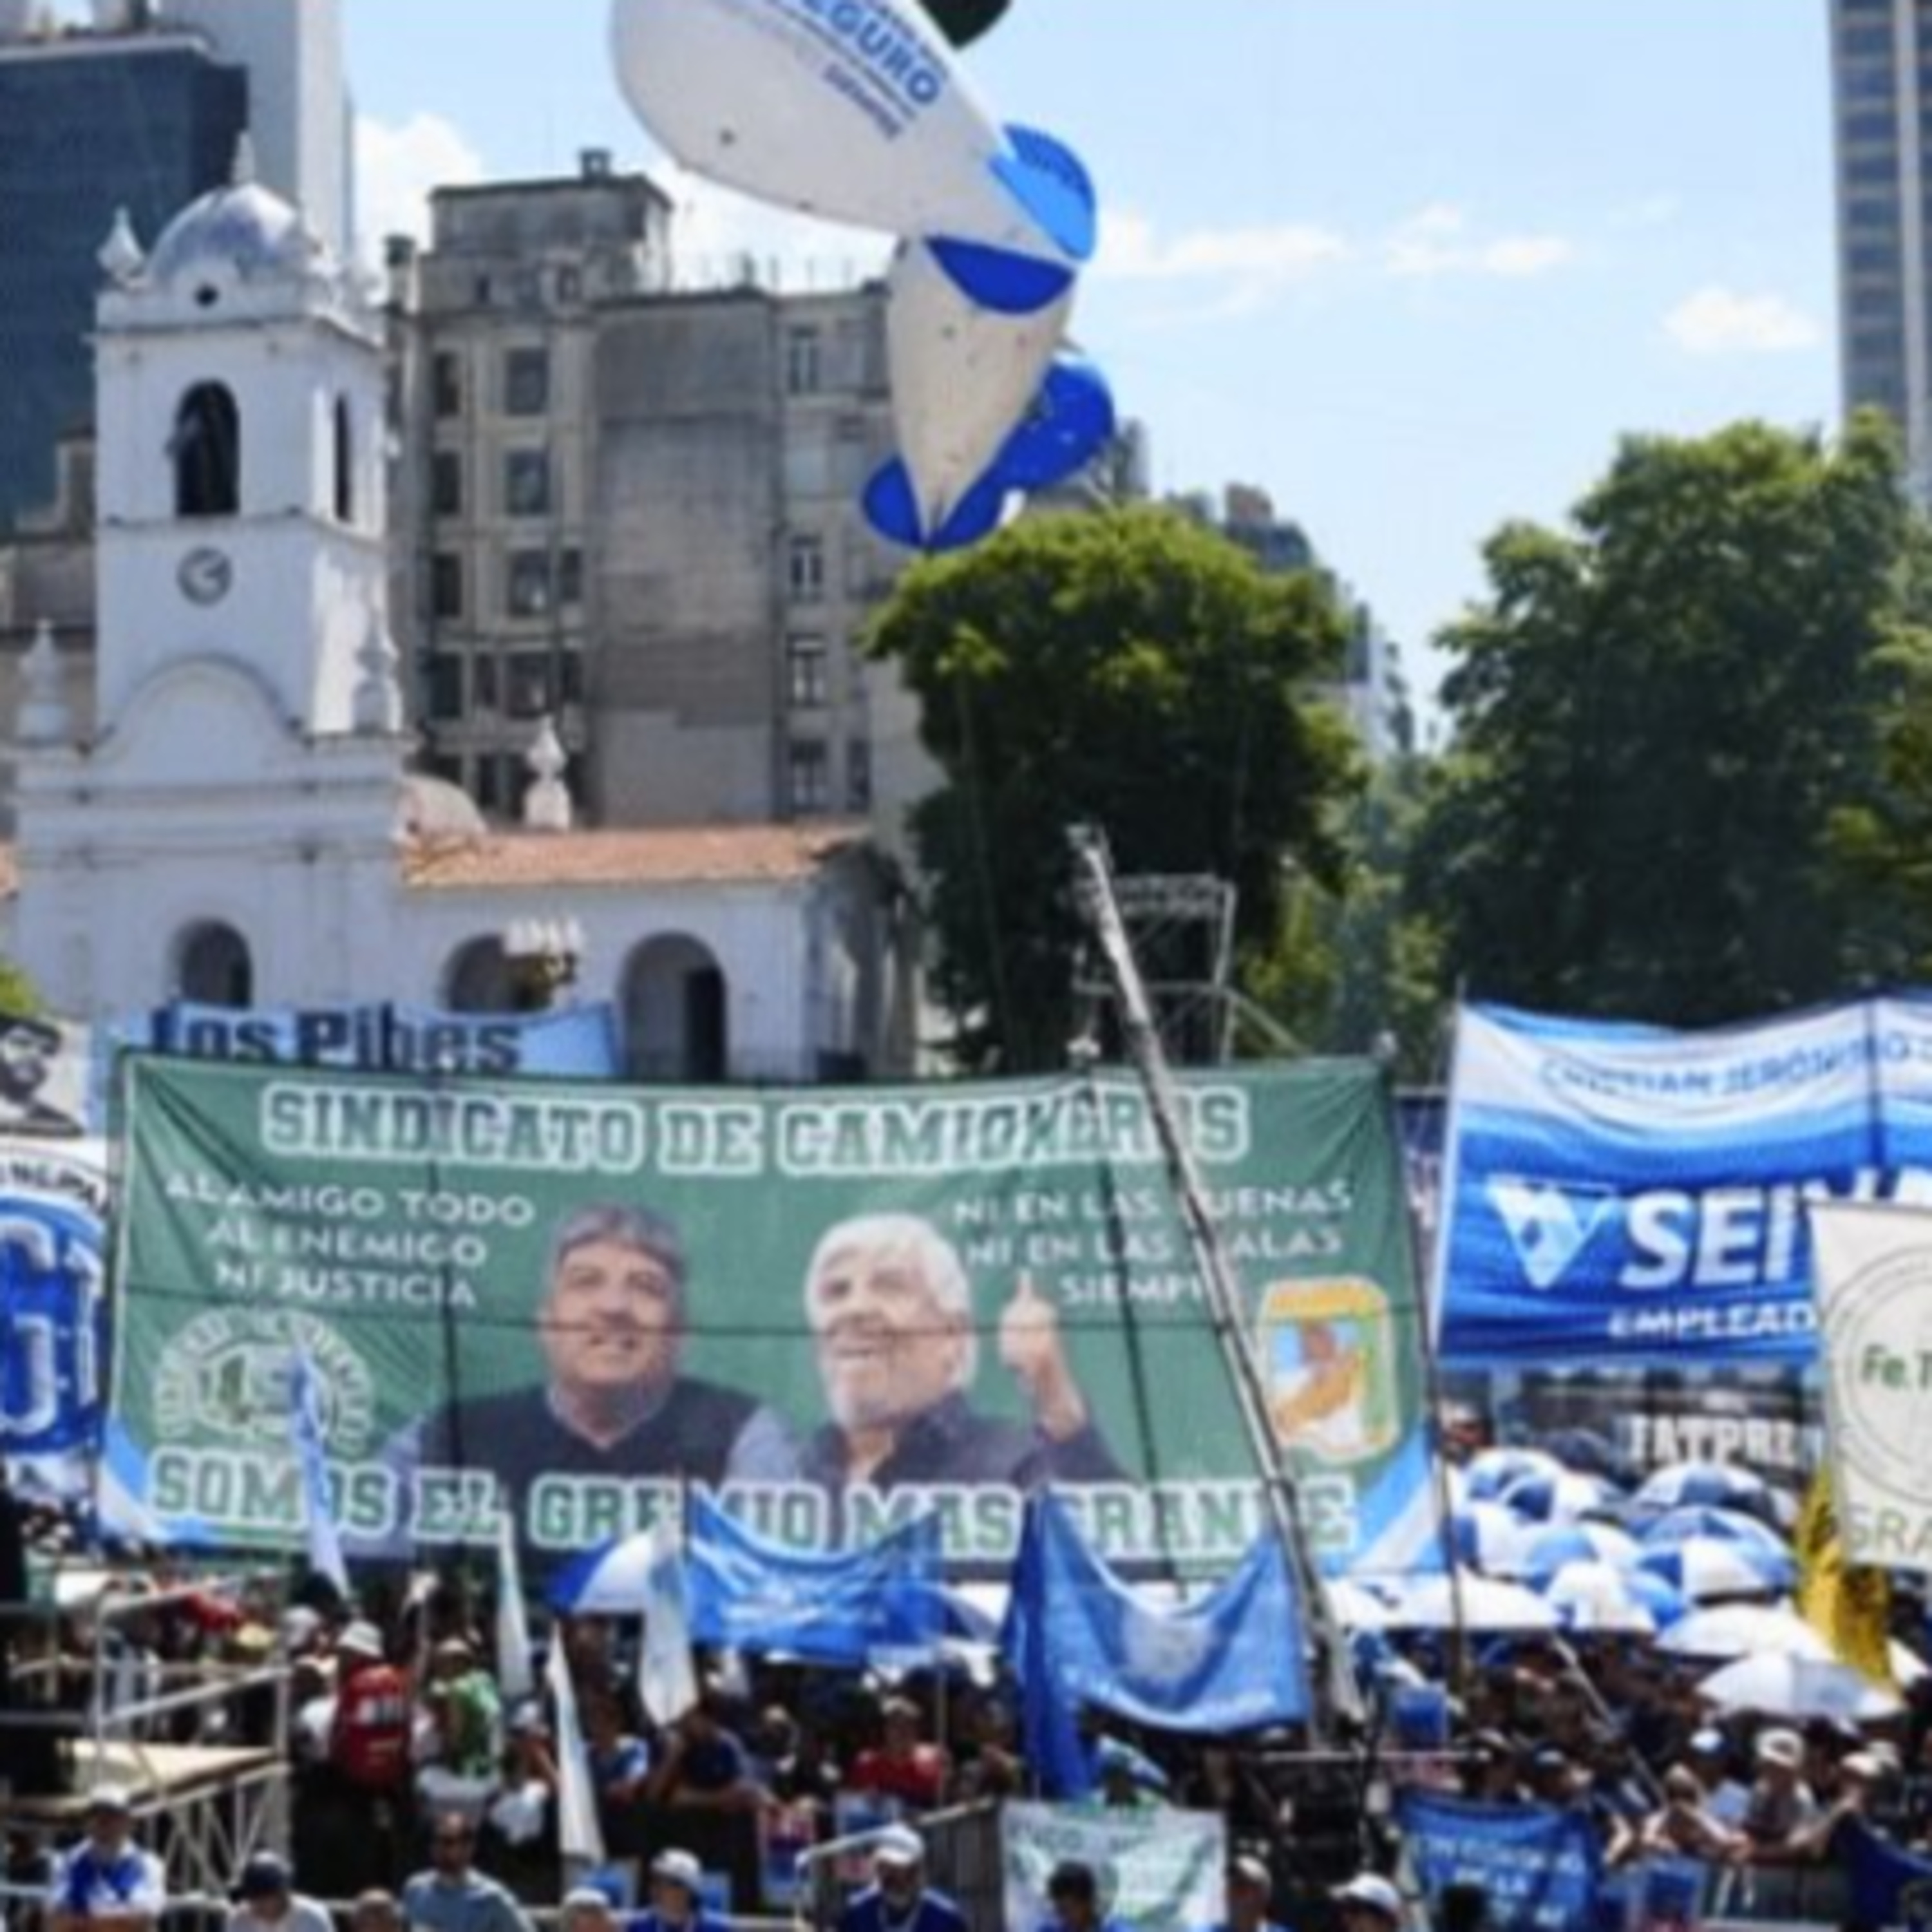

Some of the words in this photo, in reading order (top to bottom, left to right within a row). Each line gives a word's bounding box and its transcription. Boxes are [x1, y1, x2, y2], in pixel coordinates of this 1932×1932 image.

[263, 1081, 645, 1173] SINDICATO
[657, 1102, 764, 1177] DE
[225, 1182, 386, 1218] AMIGO
[398, 1188, 536, 1226] TODO
[954, 1198, 999, 1224] NI
[1015, 1191, 1068, 1222] EN
[1185, 1177, 1353, 1218] UENAS
[271, 1226, 488, 1268] ENEMIGO
[969, 1238, 1012, 1267] NI
[1030, 1233, 1079, 1264] EN
[276, 1267, 477, 1307] JUSTICIA
[410, 1466, 505, 1544] EL
